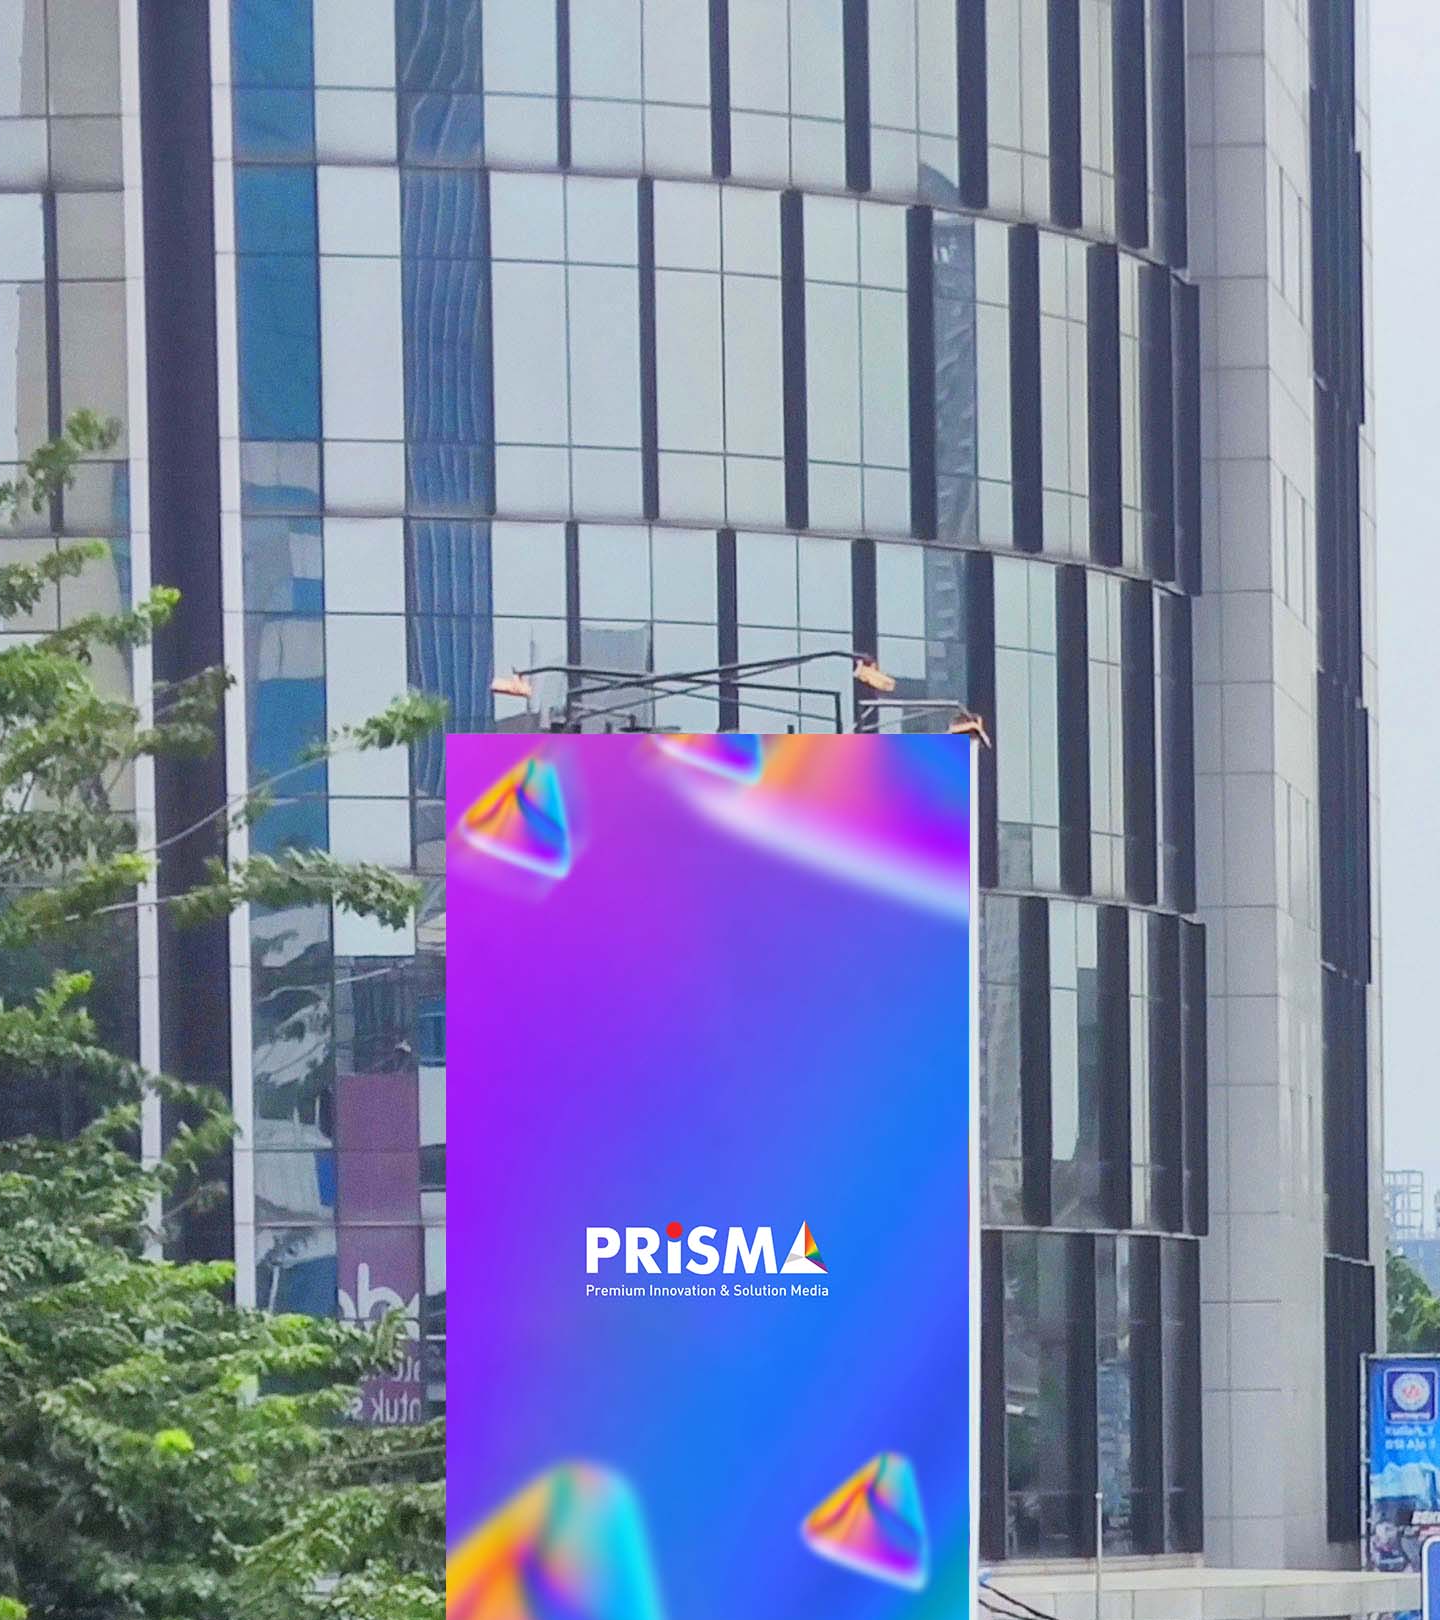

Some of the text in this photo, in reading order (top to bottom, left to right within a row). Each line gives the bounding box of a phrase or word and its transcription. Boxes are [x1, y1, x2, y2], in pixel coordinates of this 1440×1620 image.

[586, 1284, 829, 1297] Premium Innovation & Solution Media
